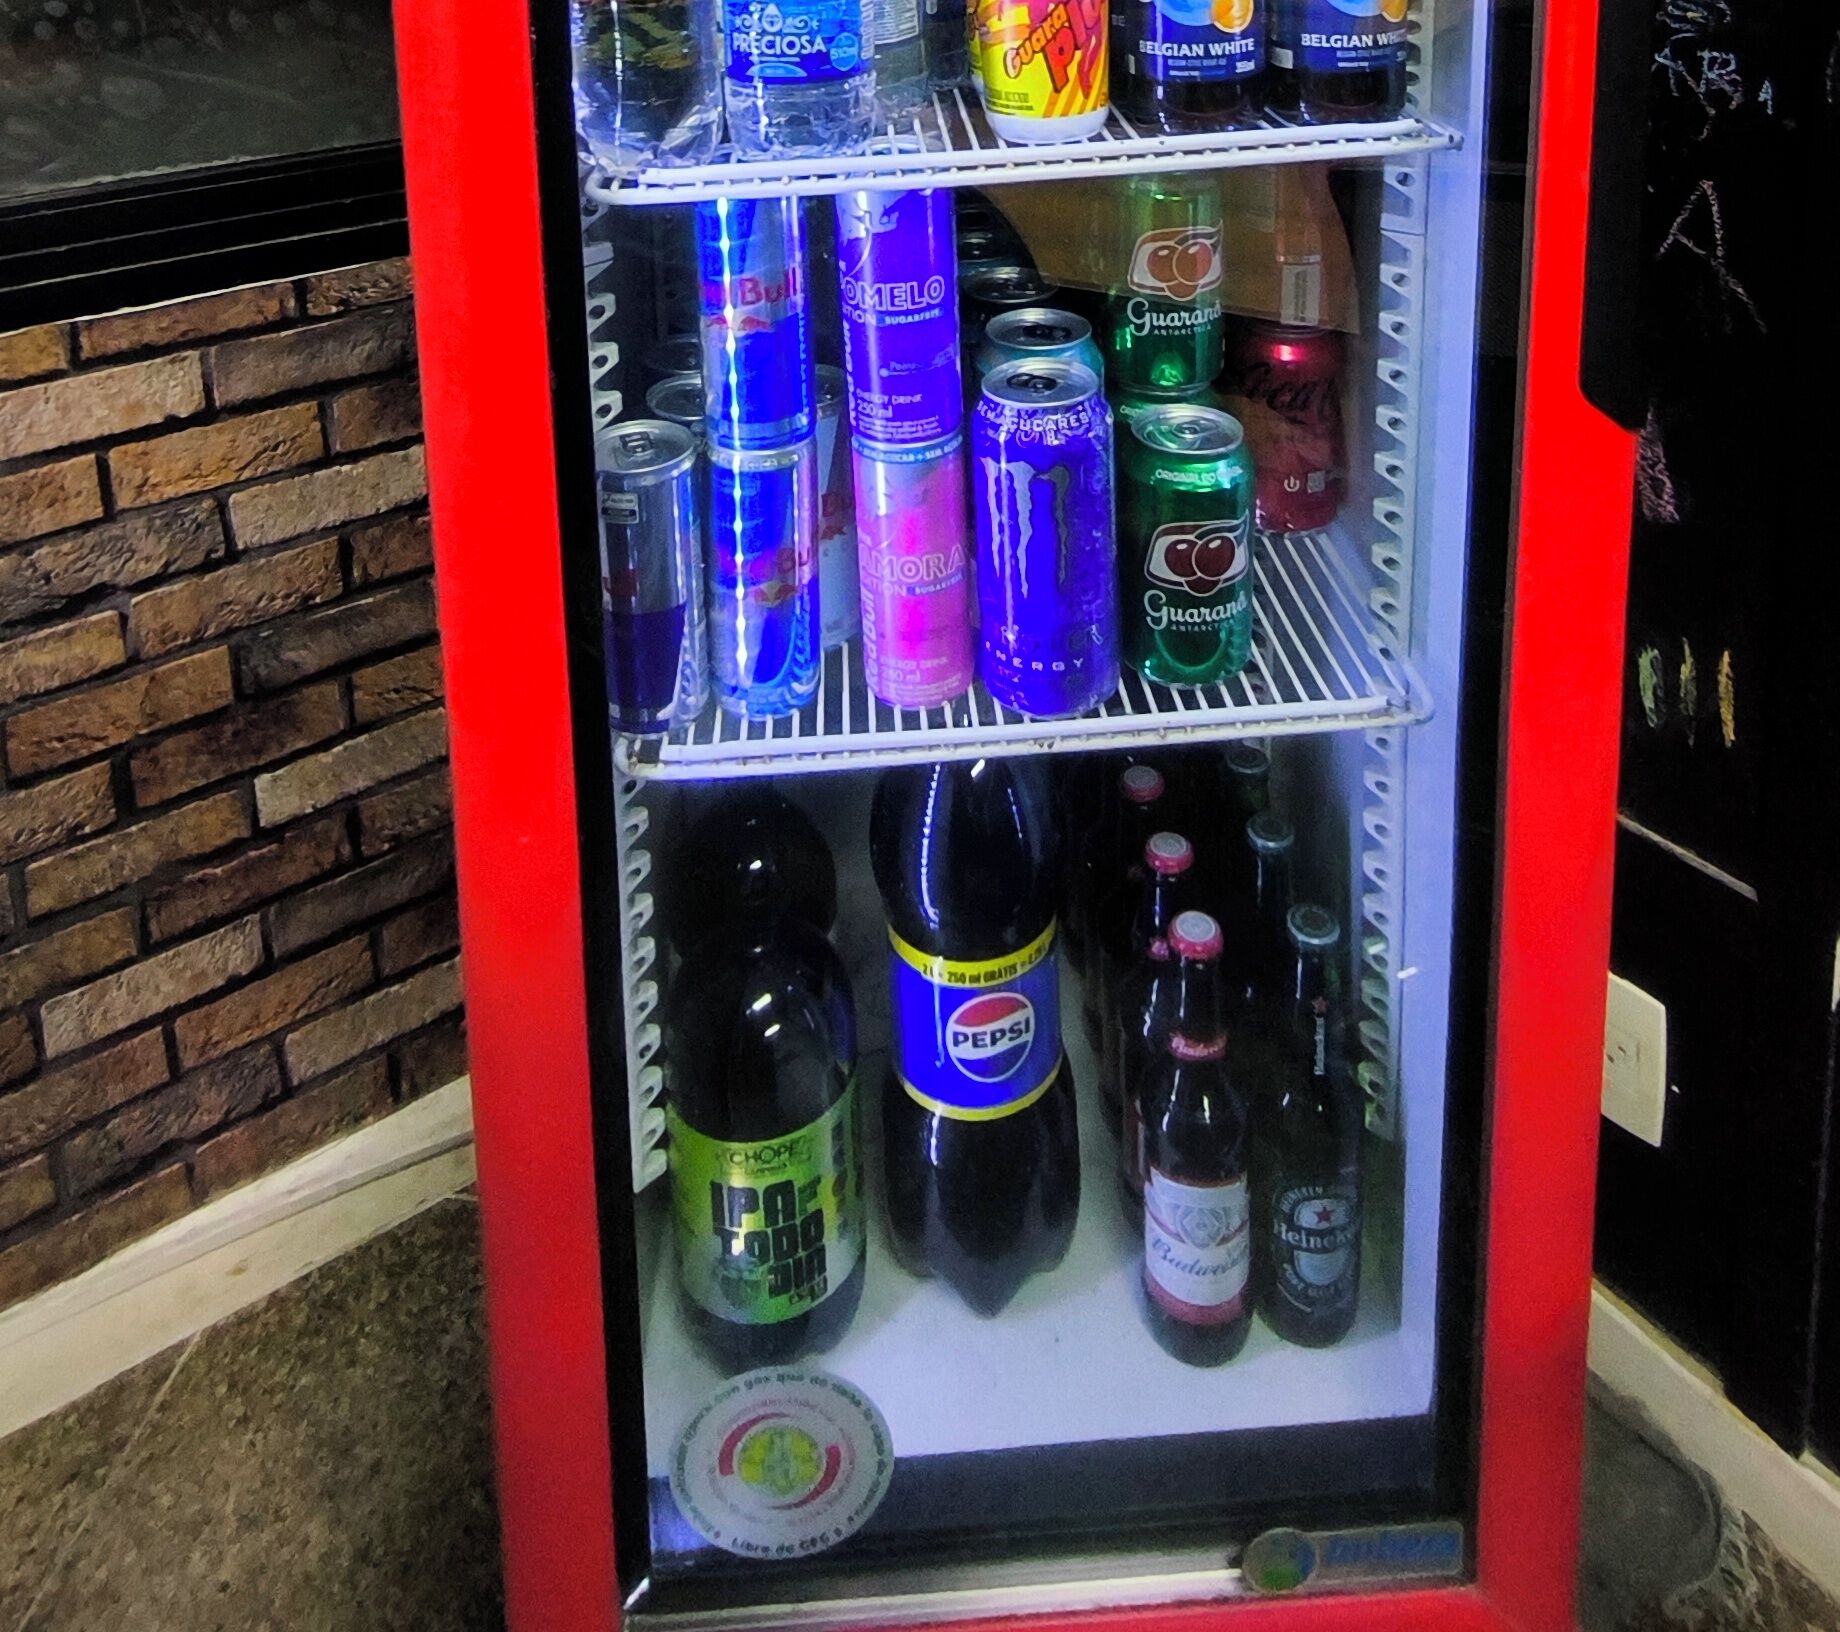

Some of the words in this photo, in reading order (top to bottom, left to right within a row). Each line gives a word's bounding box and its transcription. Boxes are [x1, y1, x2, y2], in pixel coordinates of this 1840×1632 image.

[732, 33, 828, 55] PRECIOSA
[1139, 40, 1204, 56] BELGIAN
[1208, 38, 1255, 56] WHITE
[1301, 33, 1373, 48] BELGIAN
[953, 1017, 1030, 1049] PEPSI
